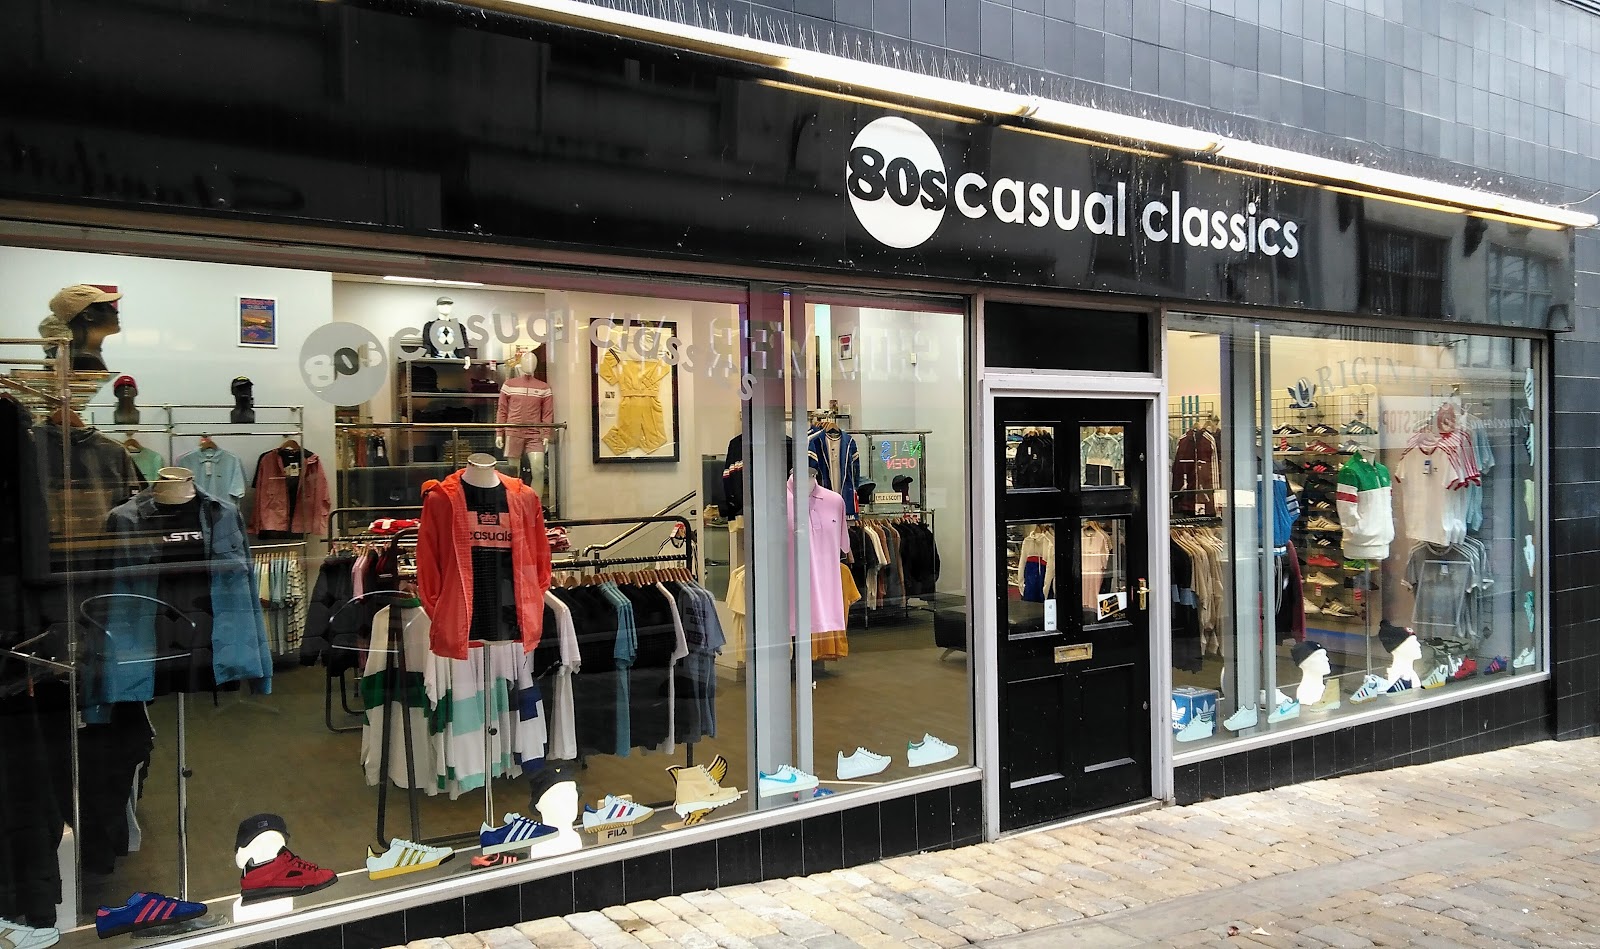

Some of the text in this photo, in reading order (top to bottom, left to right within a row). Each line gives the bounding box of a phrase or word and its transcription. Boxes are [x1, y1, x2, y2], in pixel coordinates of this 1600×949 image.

[848, 146, 1299, 259] 80s casual classics
[304, 341, 383, 388] 80s
[394, 302, 569, 361] casual
[589, 312, 758, 401] classs
[607, 827, 627, 838] FILA
